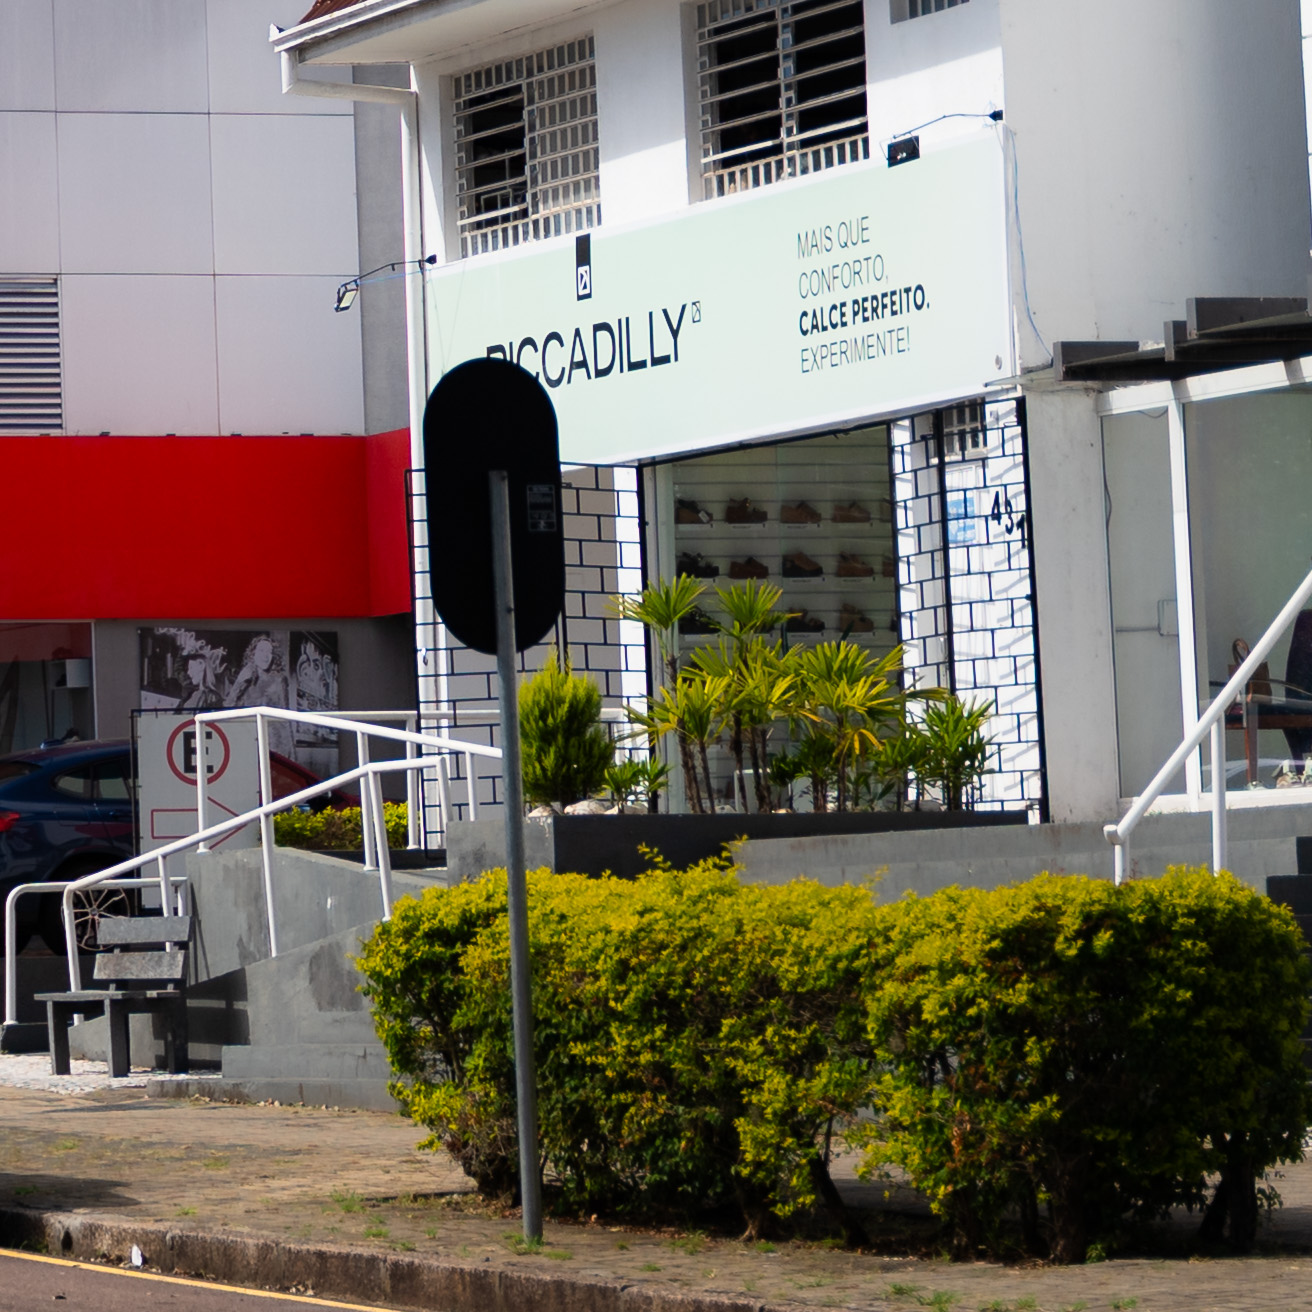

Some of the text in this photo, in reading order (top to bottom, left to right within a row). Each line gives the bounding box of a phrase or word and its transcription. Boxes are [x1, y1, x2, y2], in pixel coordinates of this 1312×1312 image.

[797, 216, 870, 259] MAIS QUE
[798, 254, 889, 299] CONFORTO,
[799, 283, 930, 336] CALCE PERFEITO.
[801, 325, 911, 374] EXPERIMENTE!
[990, 490, 1026, 549] 431
